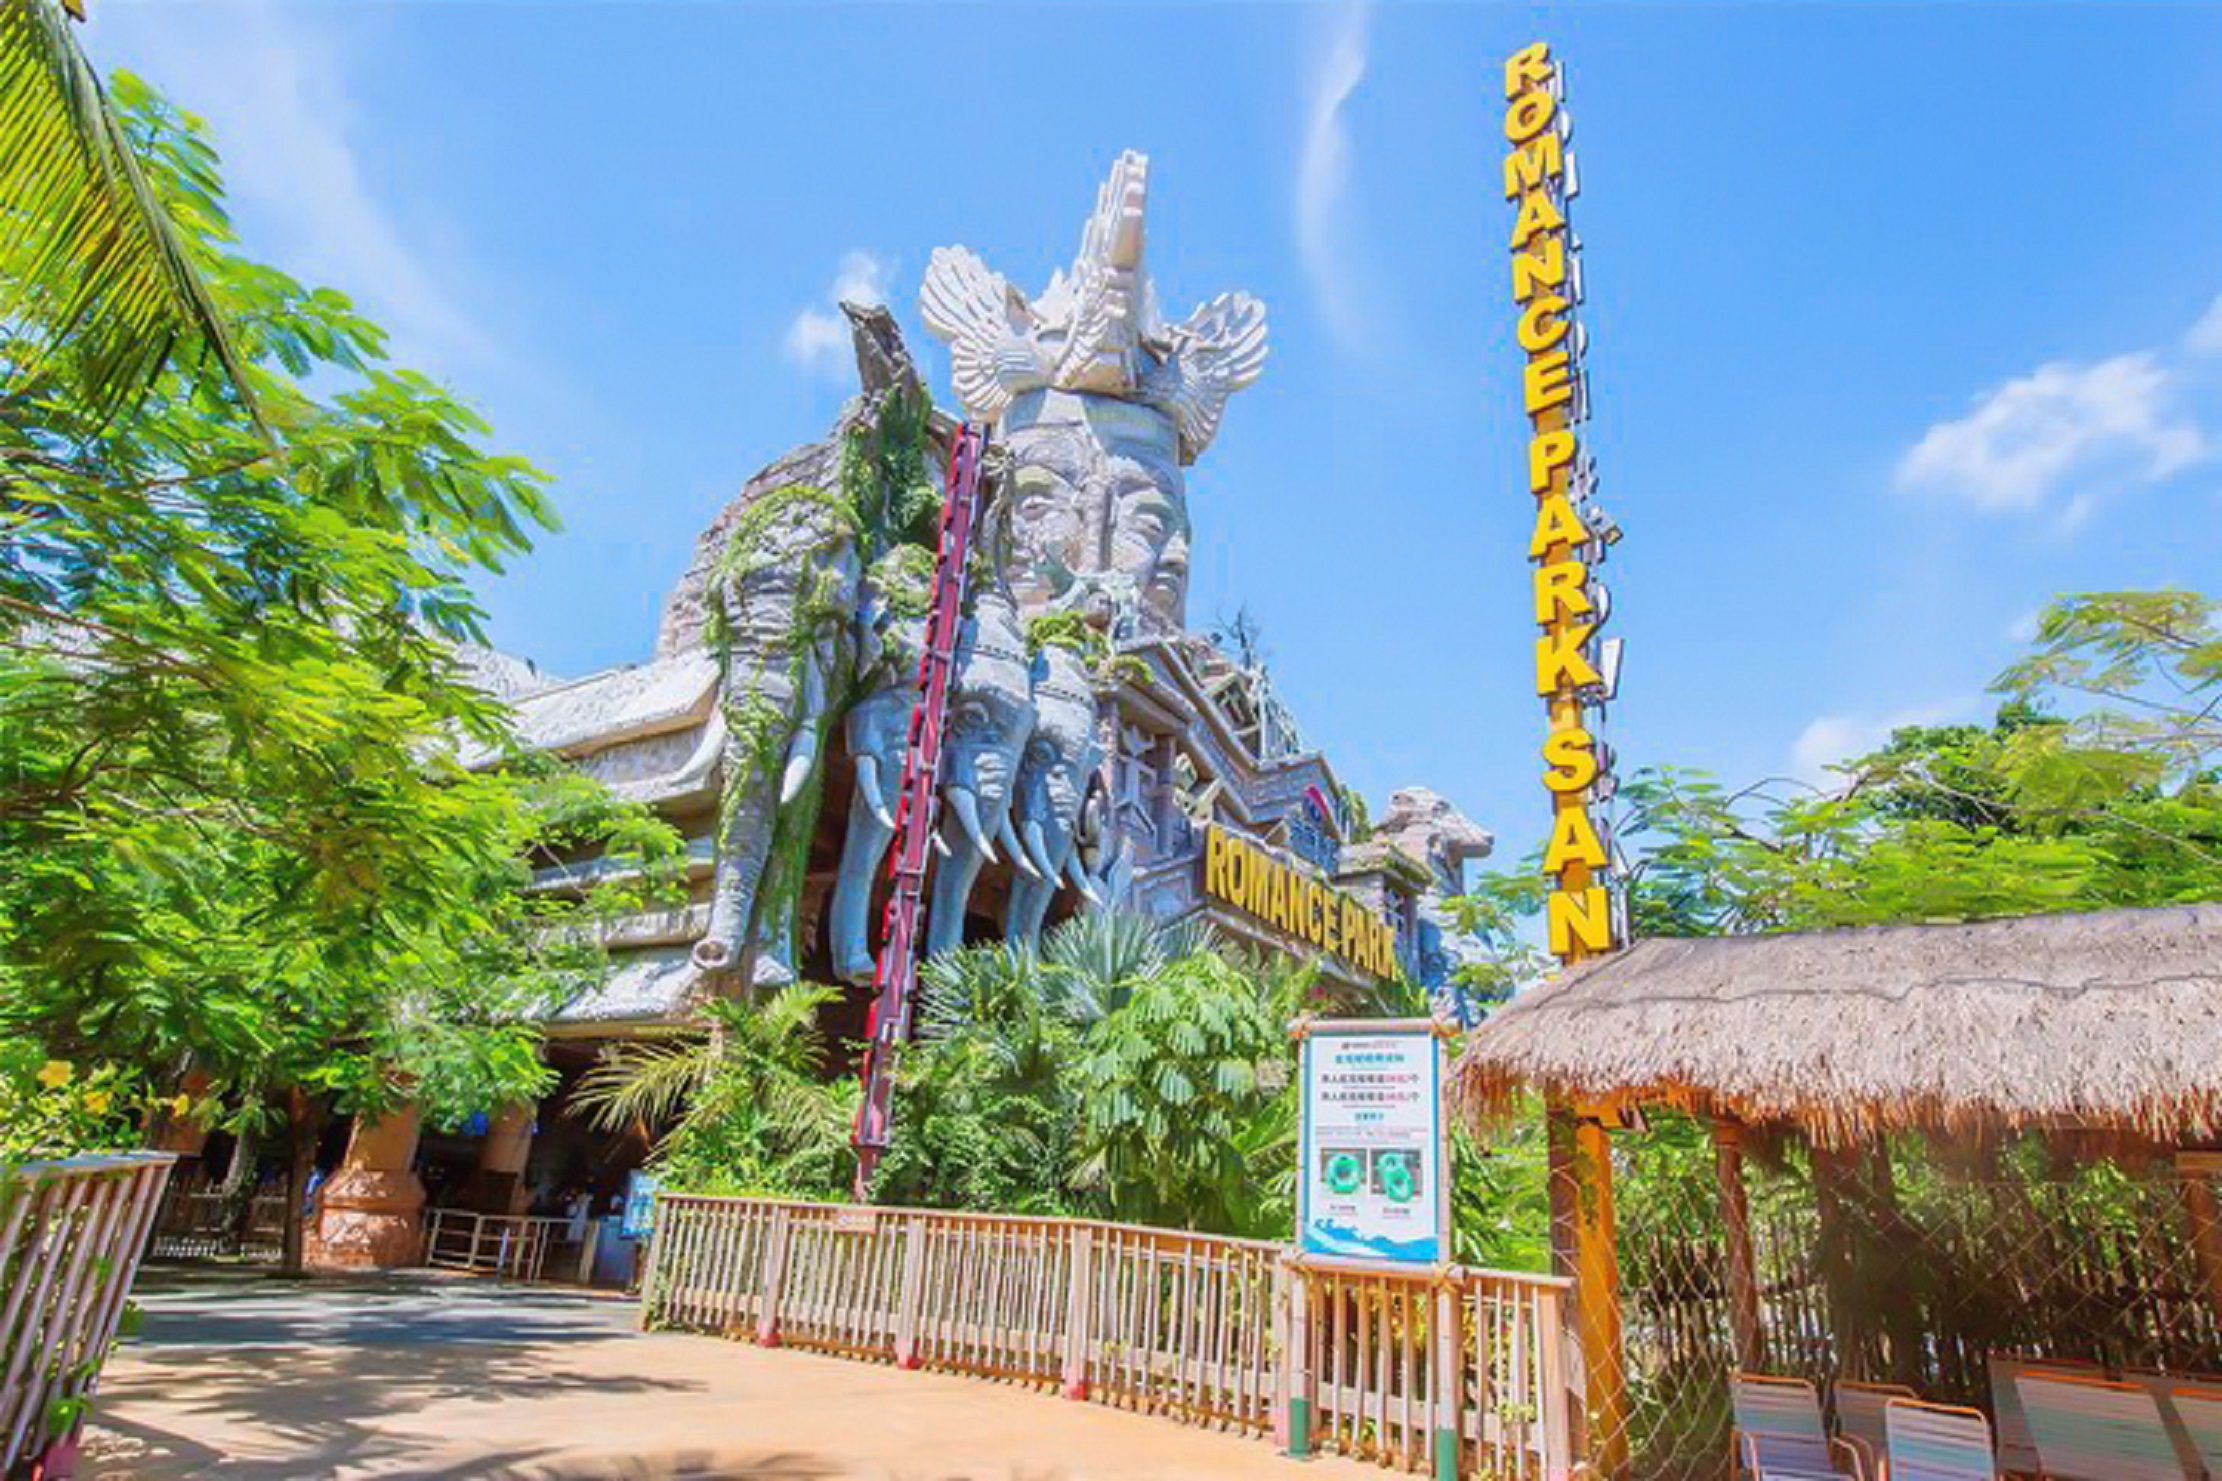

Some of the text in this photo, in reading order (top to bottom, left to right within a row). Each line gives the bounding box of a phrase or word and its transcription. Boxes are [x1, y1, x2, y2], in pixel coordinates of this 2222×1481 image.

[1506, 41, 1612, 956] ROMANCE PARK SAN
[1206, 823, 1396, 982] ROMANCE PARK
